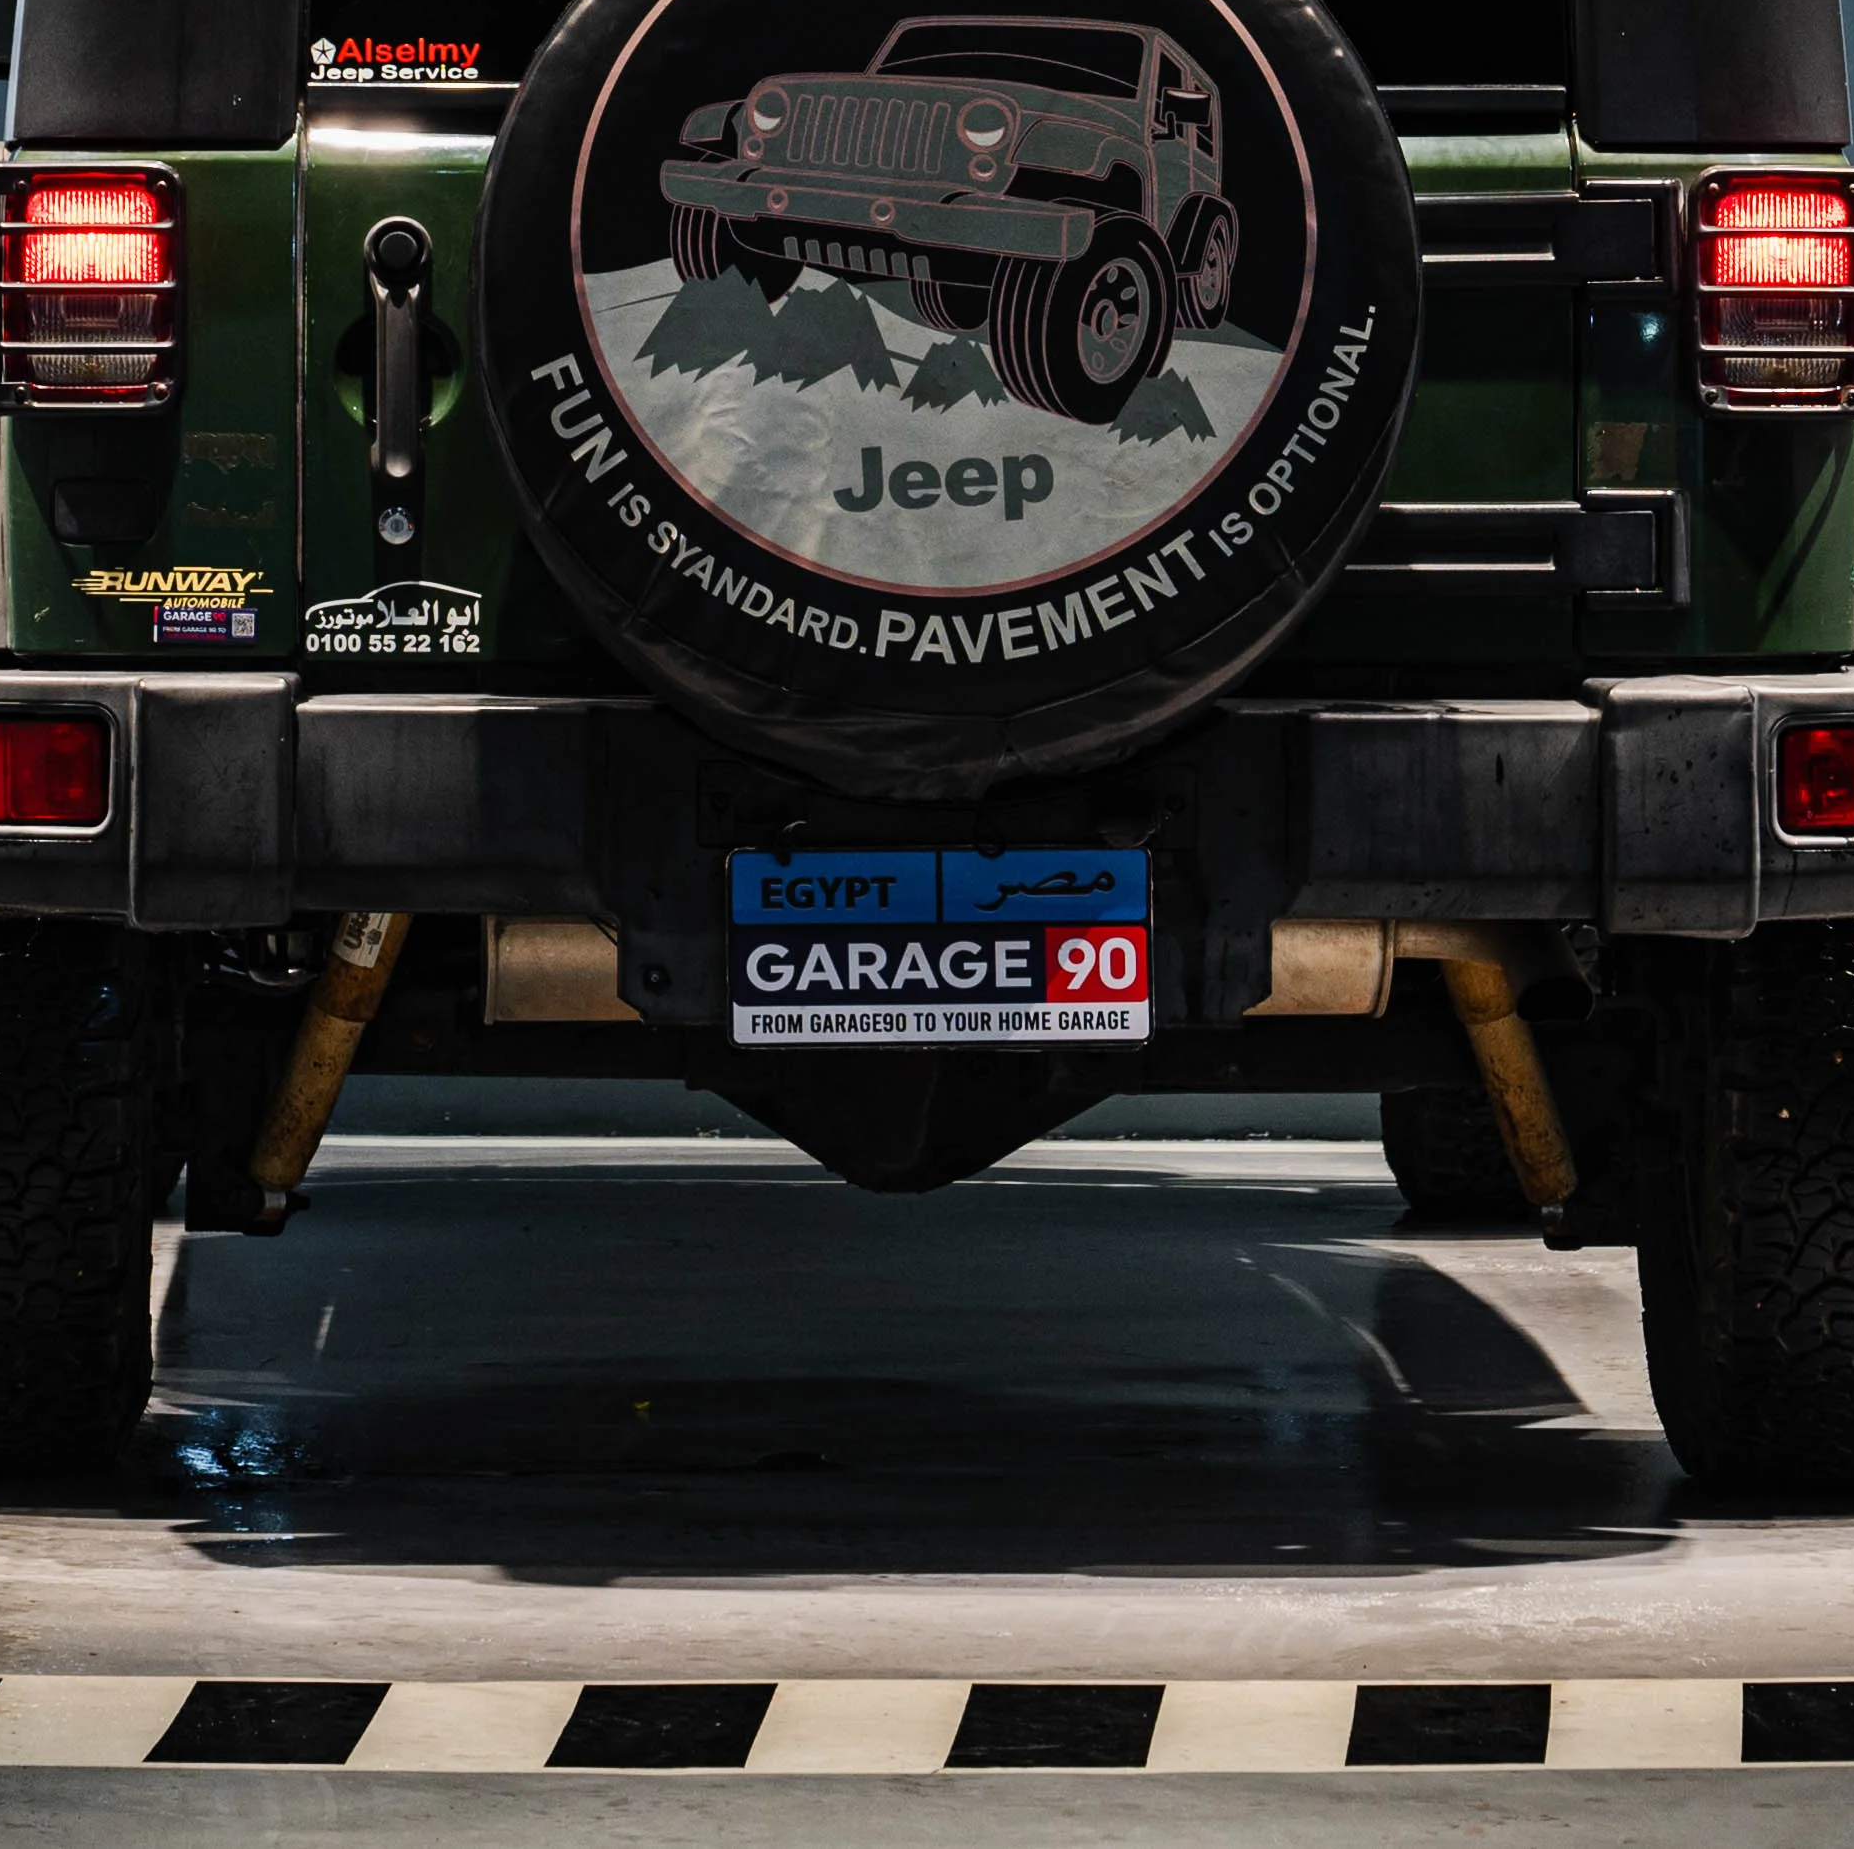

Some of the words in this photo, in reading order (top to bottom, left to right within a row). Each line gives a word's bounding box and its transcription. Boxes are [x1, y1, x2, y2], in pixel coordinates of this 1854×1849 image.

[336, 37, 481, 68] Alselmy
[310, 64, 374, 82] Jeep
[380, 64, 479, 80] Service
[531, 353, 628, 483] FUN
[607, 482, 651, 527] IS
[647, 521, 867, 654] SYANDARD.
[875, 529, 1206, 664] PAVEMENT
[1208, 512, 1254, 557] IS
[1248, 305, 1376, 515] OPTIONAL.
[833, 446, 1055, 521] Jeep
[89, 571, 257, 592] RUNWAY
[305, 633, 362, 653] 0100
[368, 634, 396, 653] 55
[403, 634, 432, 653] 22
[439, 634, 480, 653] 162
[760, 876, 897, 910] EGYPT
[973, 870, 1116, 912] مصر
[747, 940, 1032, 991] GARAGE
[1057, 937, 1137, 991] 90
[751, 1013, 803, 1035] FROM
[809, 1013, 907, 1034] GARAGE90
[914, 1012, 937, 1033] TO
[943, 1012, 993, 1032] YOUR
[998, 1012, 1052, 1032] HOME
[1058, 1011, 1131, 1031] GARAGE
